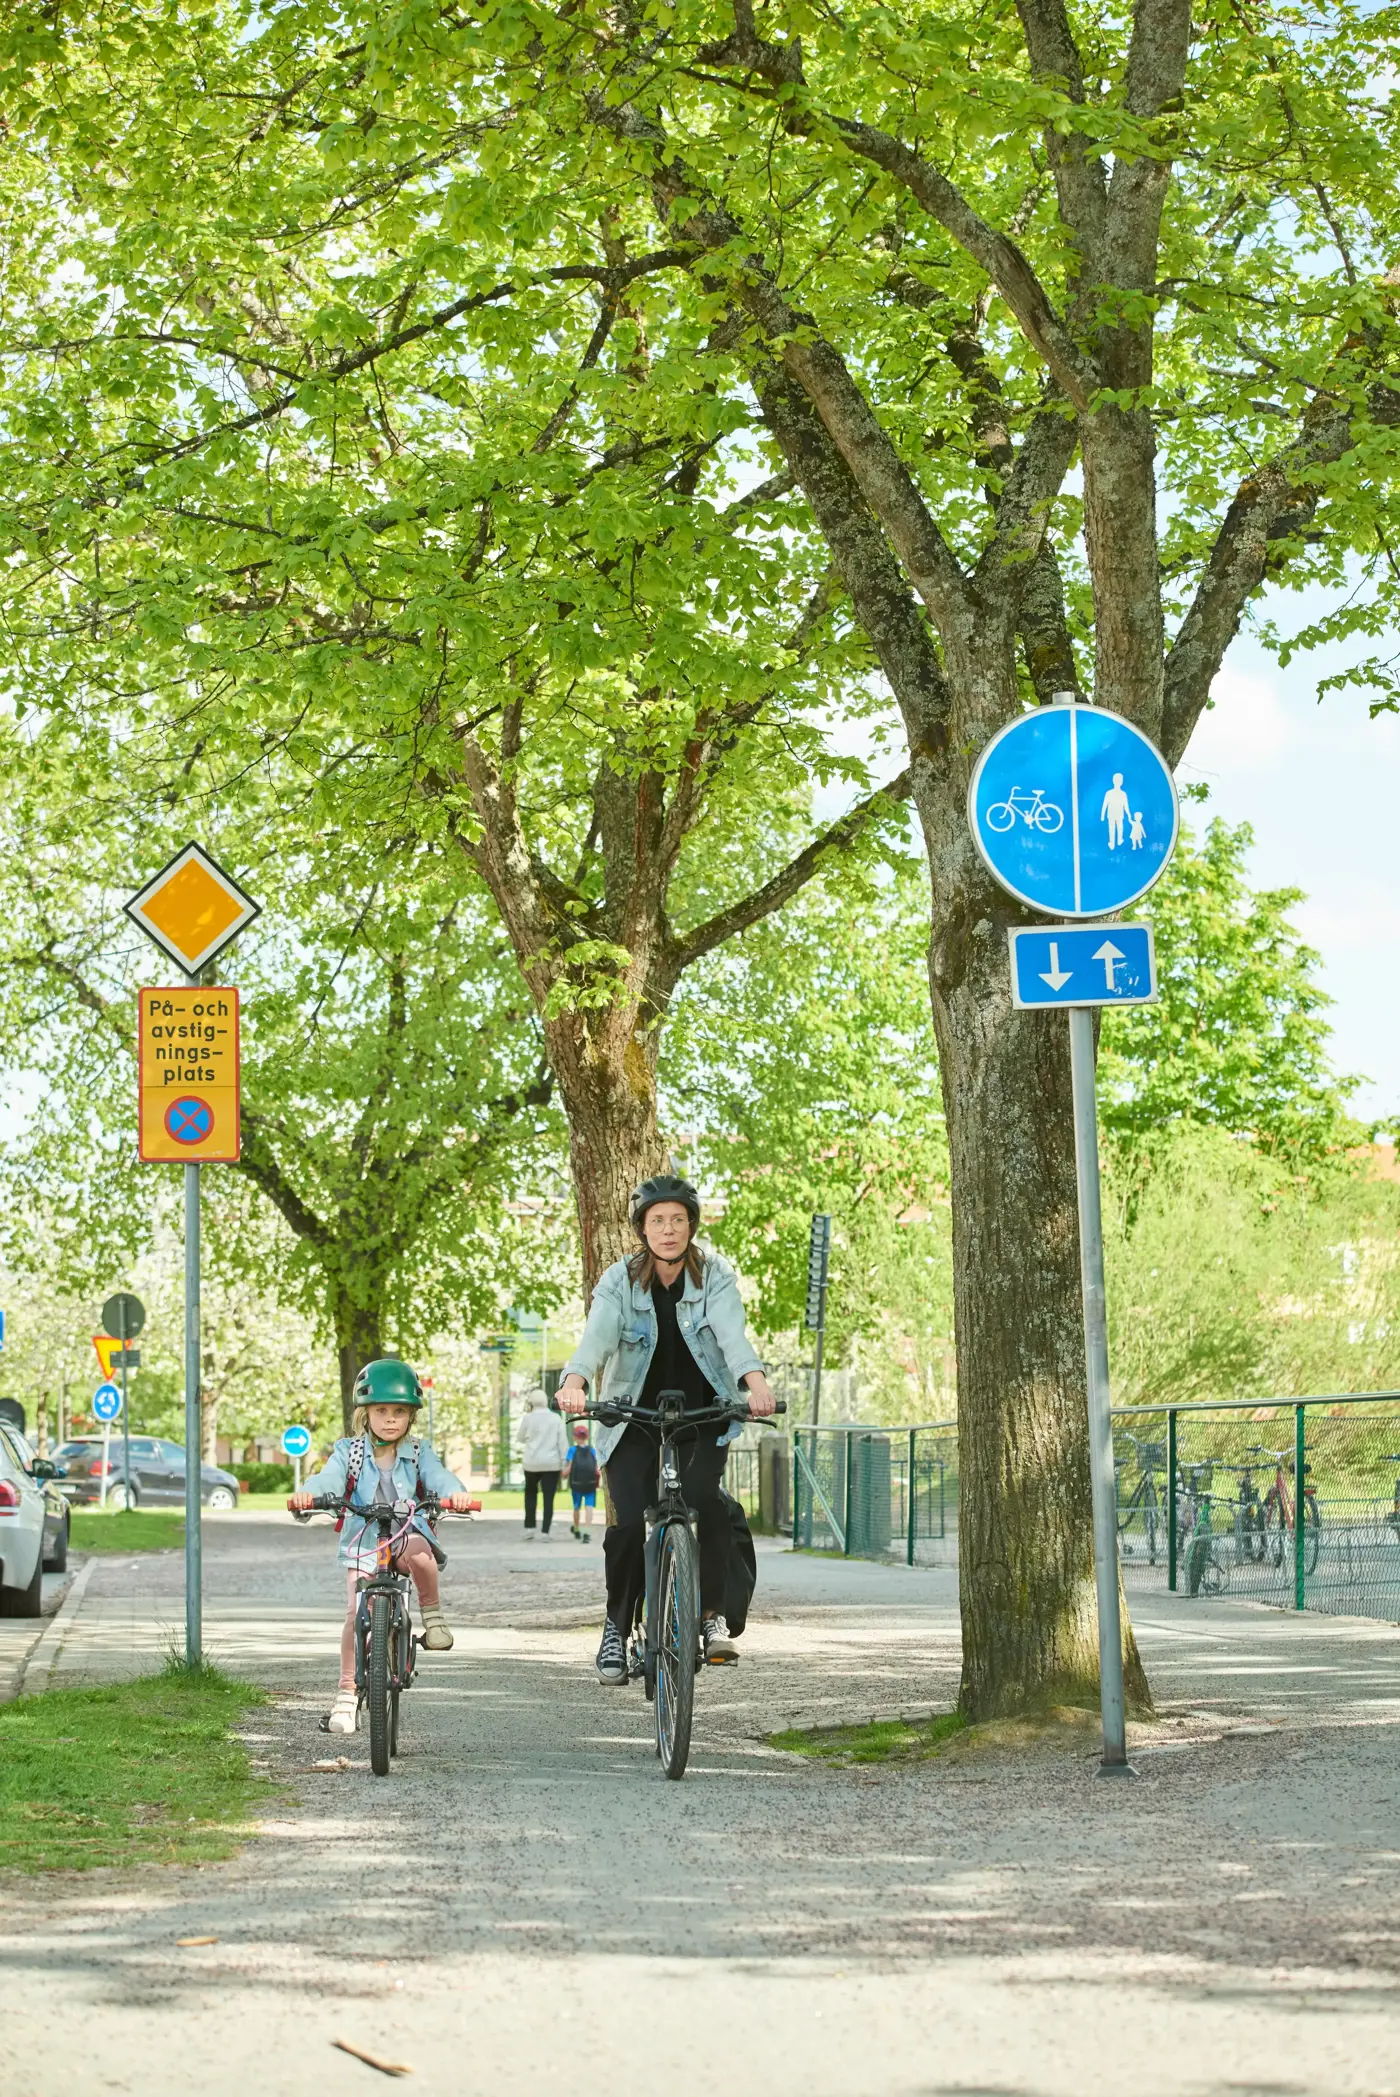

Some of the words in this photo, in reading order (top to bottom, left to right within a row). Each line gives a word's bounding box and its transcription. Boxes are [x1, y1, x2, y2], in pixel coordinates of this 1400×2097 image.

[150, 1000, 186, 1016] På-
[192, 1000, 228, 1016] och
[151, 1022, 228, 1042] avstig-
[156, 1043, 223, 1063] nings-
[163, 1065, 215, 1085] plats
